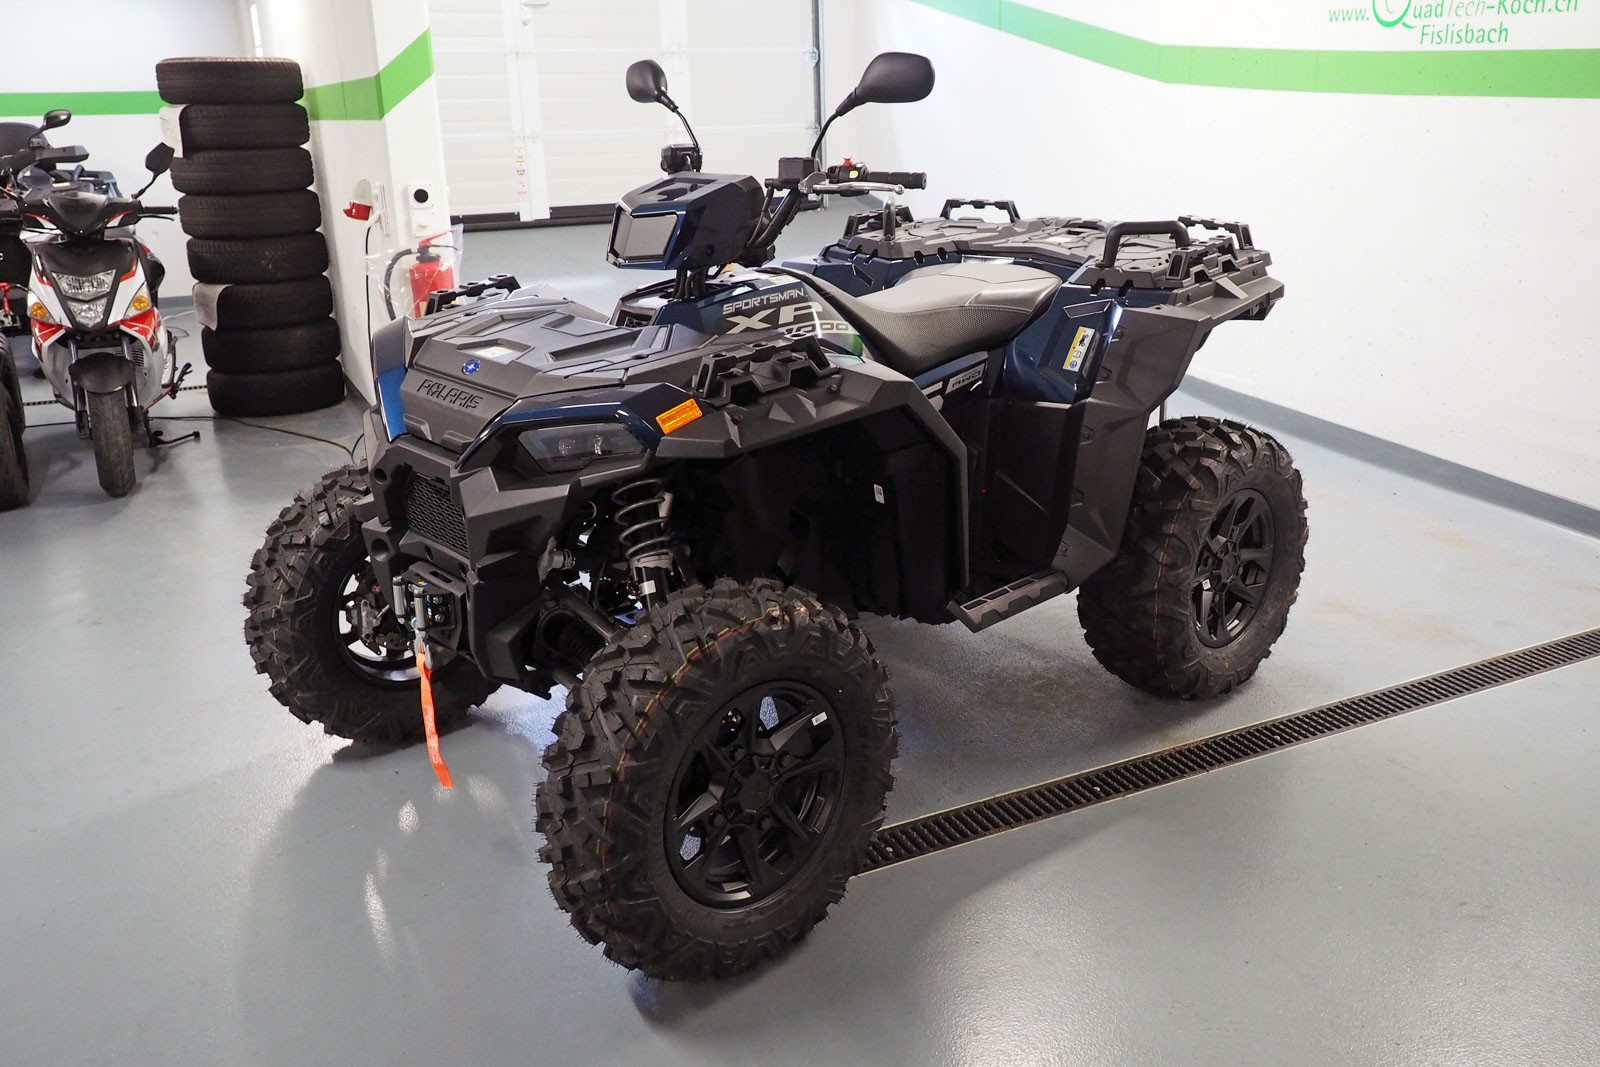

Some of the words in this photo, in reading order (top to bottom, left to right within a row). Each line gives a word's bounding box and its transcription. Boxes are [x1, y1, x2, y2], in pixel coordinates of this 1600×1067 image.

[1420, 22, 1509, 45] Fislisbach
[723, 288, 805, 315] SPORTSMAN
[725, 302, 823, 335] XP
[417, 379, 484, 409] POLARIS
[424, 704, 443, 765] POLARIS
